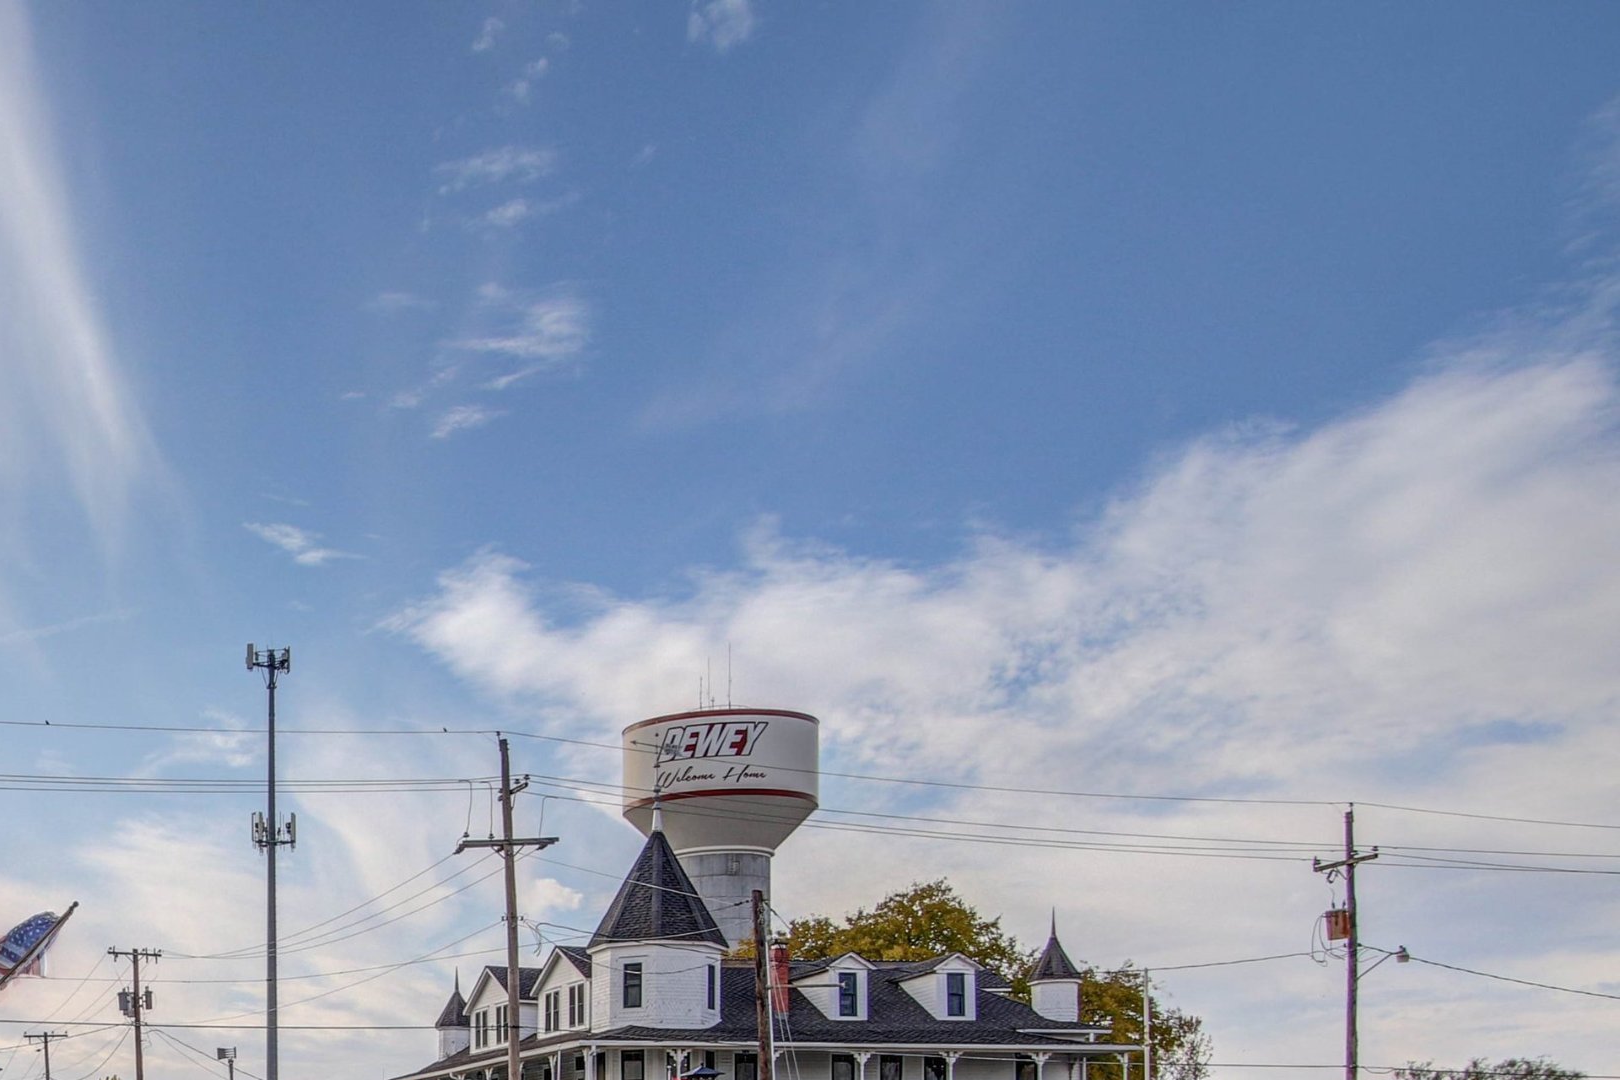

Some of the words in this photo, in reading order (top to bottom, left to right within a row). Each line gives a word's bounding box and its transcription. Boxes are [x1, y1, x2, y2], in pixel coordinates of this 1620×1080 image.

[656, 721, 769, 764] DEWEY
[657, 765, 716, 789] Welcome
[722, 764, 768, 783] Home
